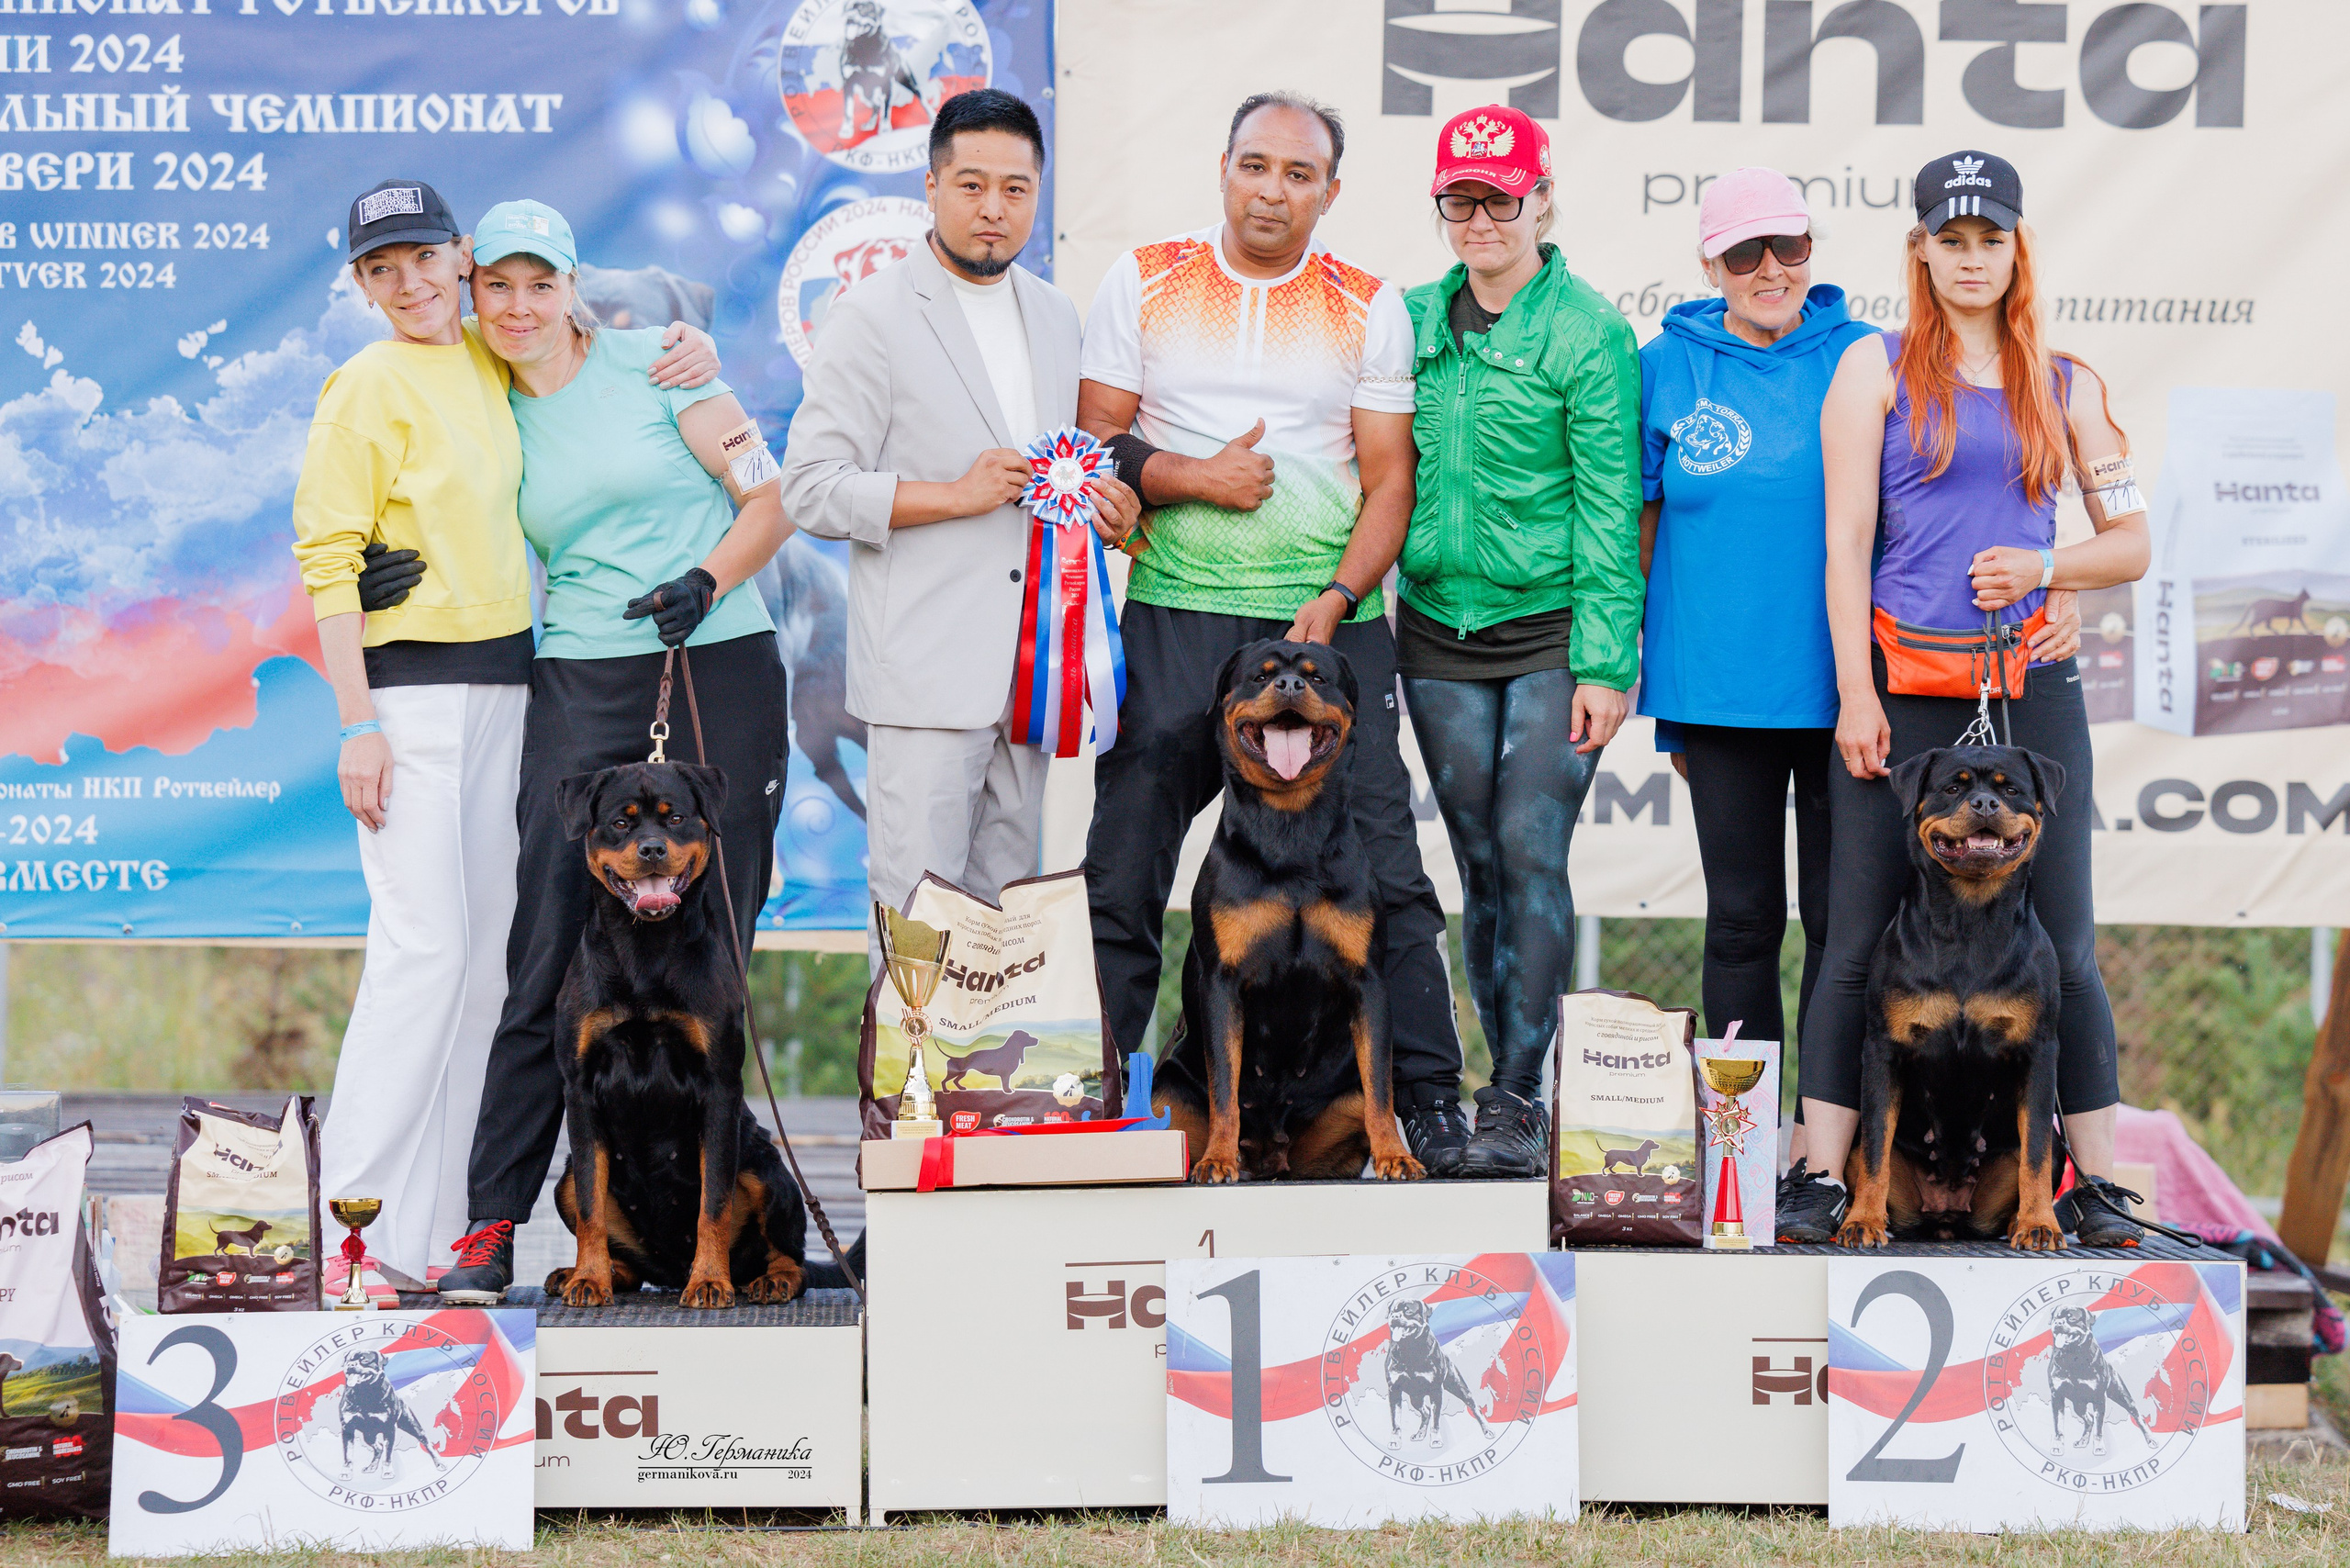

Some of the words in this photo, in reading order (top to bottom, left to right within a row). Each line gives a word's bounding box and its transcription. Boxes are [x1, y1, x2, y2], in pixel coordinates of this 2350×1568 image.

[69, 33, 185, 73] 2024
[1382, 0, 2244, 128] Hanta
[207, 92, 564, 134] ЧЕМПИОНАТ
[152, 151, 269, 191] 2024
[1944, 174, 1992, 189] adidas
[1643, 165, 1917, 214] prmiu
[842, 199, 888, 224] 2024
[29, 222, 181, 250] WINNER
[193, 222, 270, 250] 2024
[99, 262, 177, 289] 2024
[2055, 297, 2255, 324] питания
[1716, 406, 1743, 425] TORRA
[1681, 454, 1735, 473] ROTTWEILER
[2215, 481, 2321, 502] Hanta
[1070, 618, 1079, 660] класса
[2157, 580, 2174, 713] Hanta
[83, 777, 142, 799] НКП
[152, 775, 281, 803] Ротвейлер
[0, 859, 170, 890] МЕСТЕ
[942, 950, 1046, 993] Hanta
[939, 995, 1036, 1031] SMALL/MEDIUM
[1583, 1047, 1671, 1070] Hanta
[1590, 1093, 1664, 1104] SMALL/MEDIUM
[956, 1114, 975, 1123] FRESH
[956, 1122, 972, 1130] MEAT
[0, 1171, 34, 1185] рисом
[1325, 1271, 1408, 1429] РОТВЕЙЛЕР
[1425, 1267, 1498, 1302] КЛУБ
[1505, 1306, 1542, 1427] РОССИИ
[1987, 1279, 2071, 1433] РОТВЕЙЛЕР
[2088, 1275, 2165, 1312] КЛУБ
[2168, 1318, 2207, 1439] РОССИИ
[277, 1326, 365, 1463] РОТВЕЙЛЕР
[383, 1322, 455, 1353] КЛУБ
[462, 1357, 496, 1461] РОССИИ
[1196, 1269, 1293, 1484] 1
[1845, 1270, 1966, 1484] 2
[138, 1325, 243, 1514] 3
[65, 1474, 82, 1483] FREE
[1378, 1448, 1498, 1484] РКФ-НКПР
[2040, 1457, 2161, 1492] РКФ-НКПР
[329, 1478, 450, 1509] РКФ-НКПР
